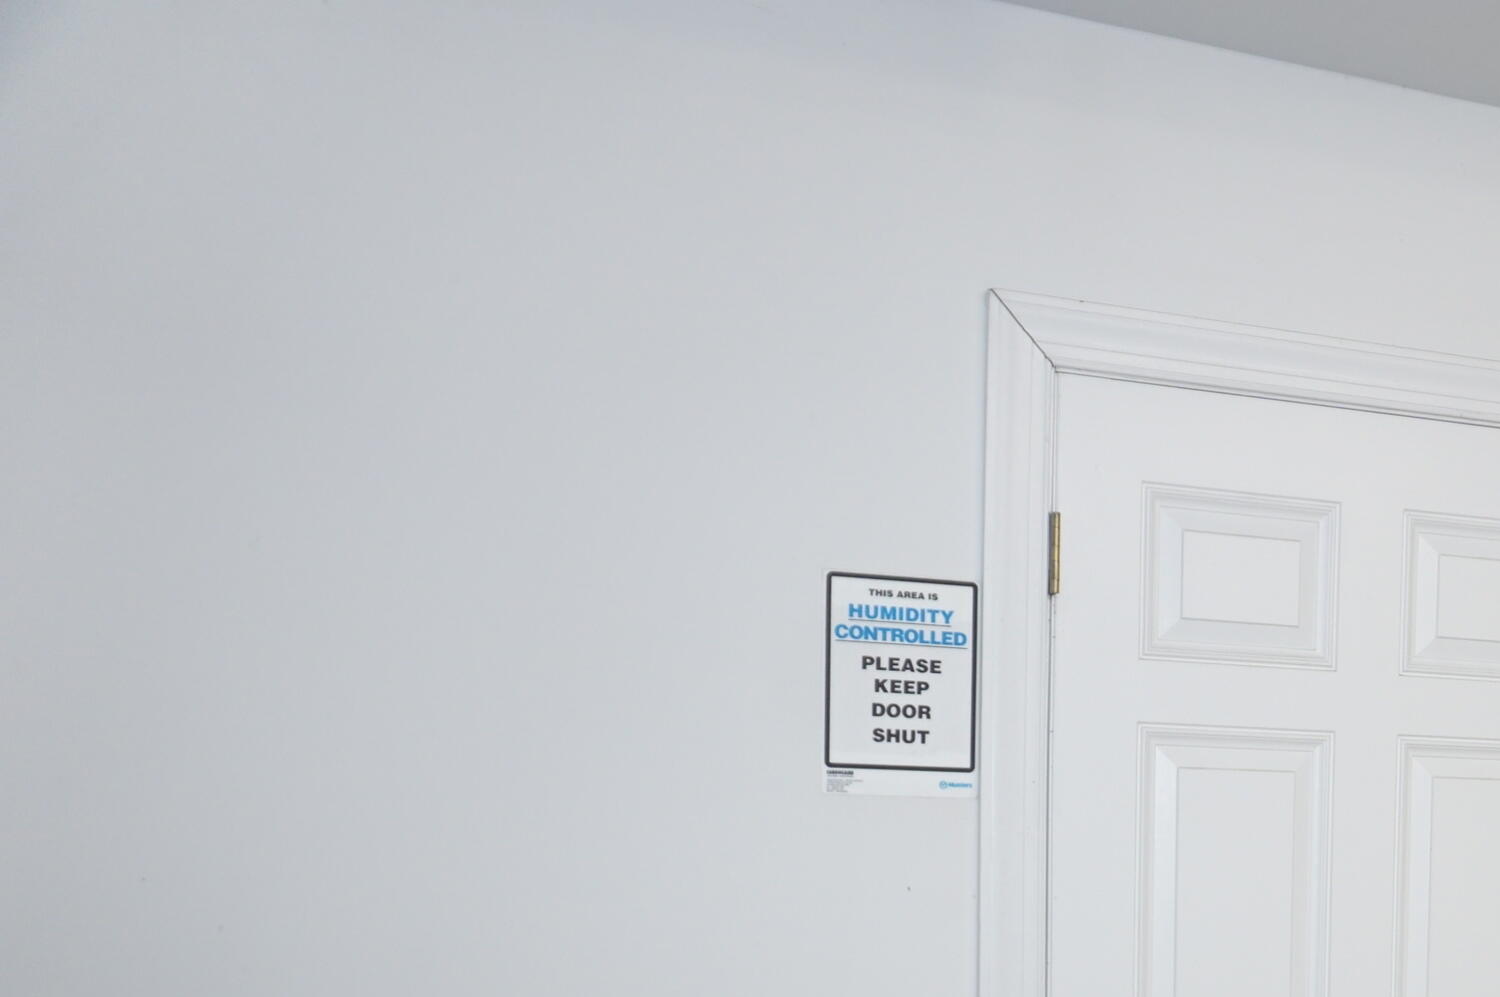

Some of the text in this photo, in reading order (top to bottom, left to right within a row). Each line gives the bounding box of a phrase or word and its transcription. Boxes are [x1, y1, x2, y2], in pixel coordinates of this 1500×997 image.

[869, 588, 939, 601] THIS AREA IS
[848, 603, 954, 625] HUMIDITY
[834, 624, 968, 647] CONTROLLED
[861, 655, 943, 675] PLEASE
[874, 678, 930, 695] KEEP
[871, 702, 932, 720] DOOR
[872, 727, 930, 744] SHUT
